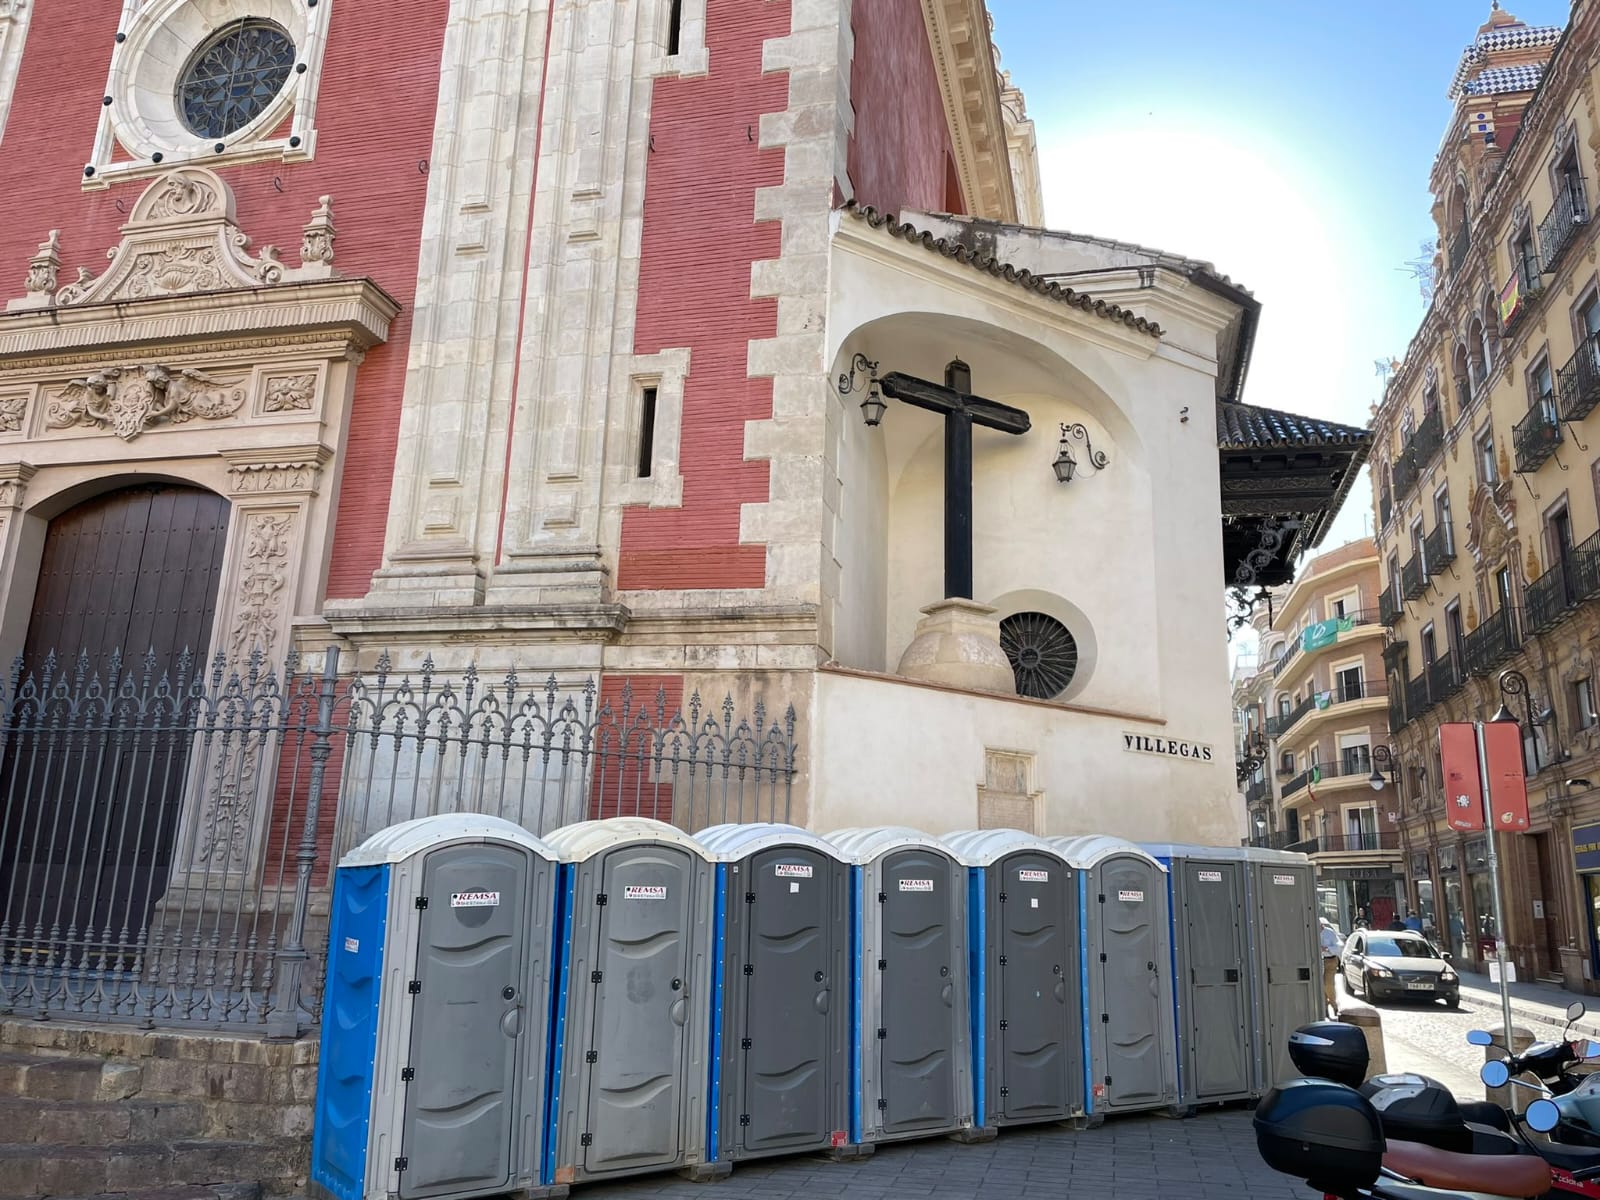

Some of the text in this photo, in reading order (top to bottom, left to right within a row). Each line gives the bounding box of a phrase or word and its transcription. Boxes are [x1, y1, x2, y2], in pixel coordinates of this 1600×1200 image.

[1124, 735, 1212, 760] VILLEGAS
[781, 865, 811, 873] REMSA
[459, 892, 497, 900] REMSA
